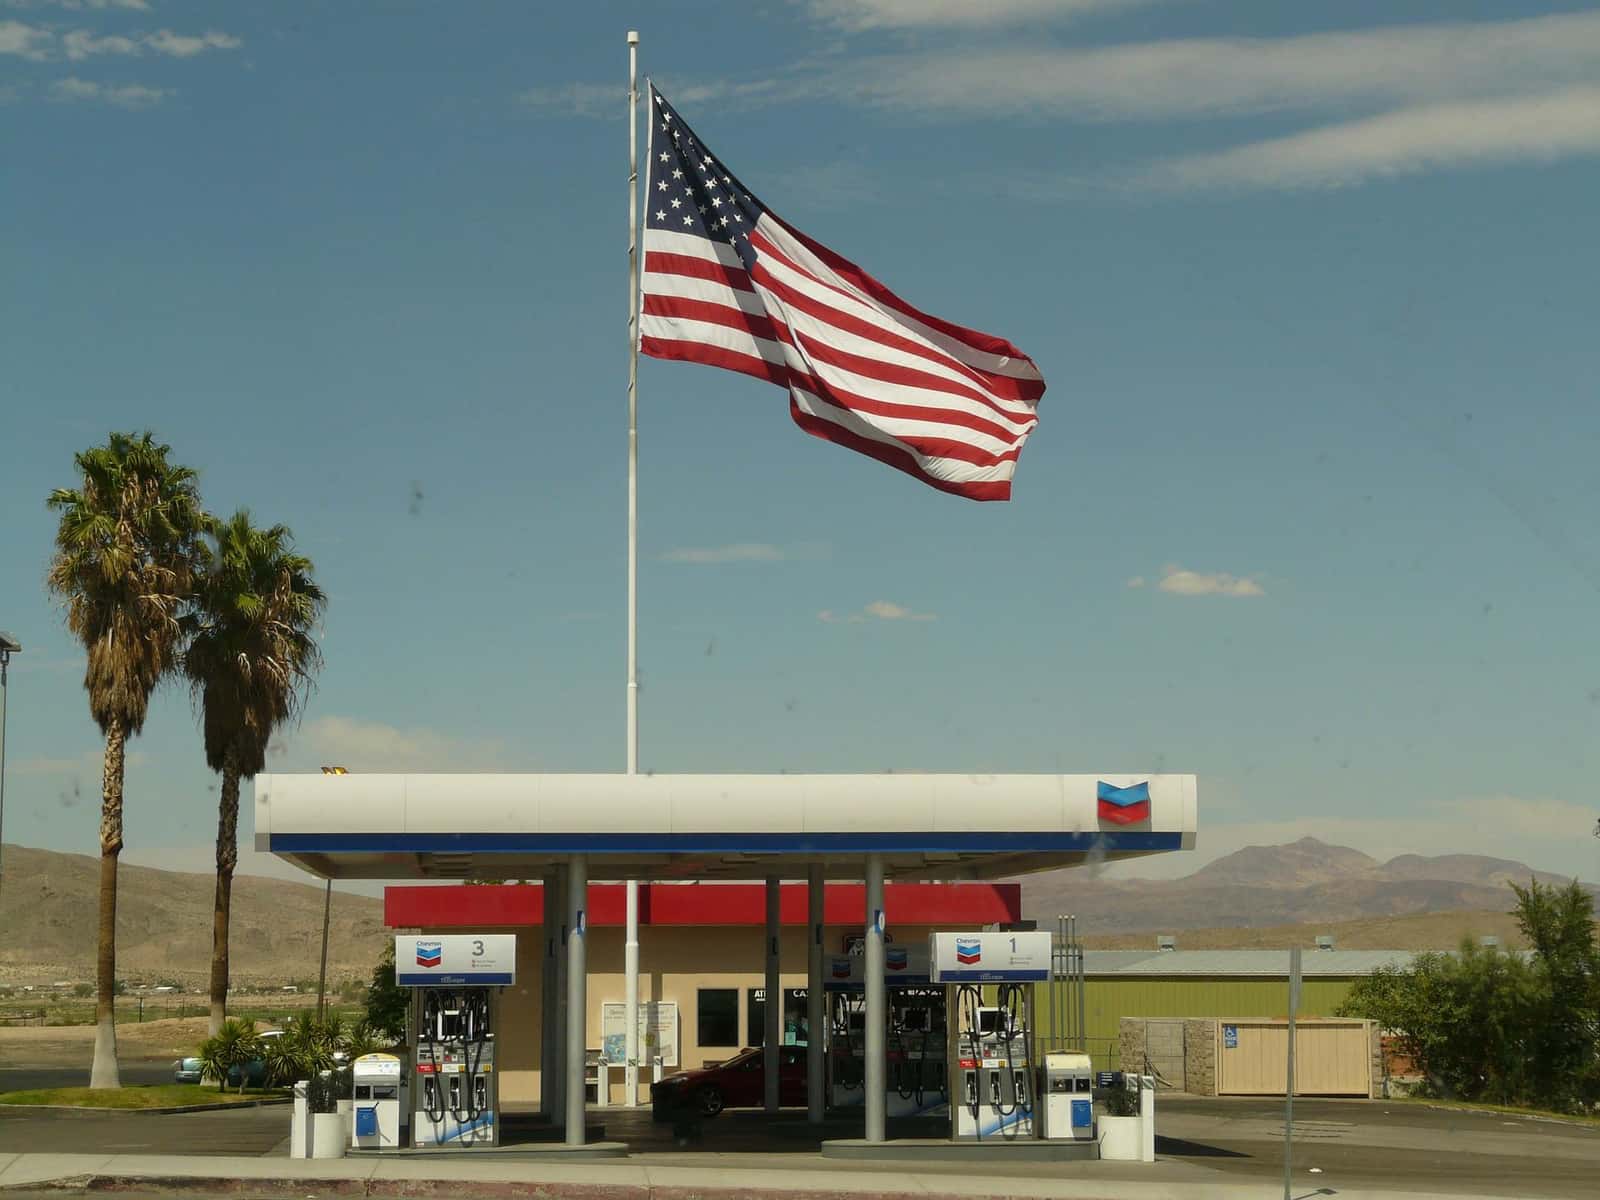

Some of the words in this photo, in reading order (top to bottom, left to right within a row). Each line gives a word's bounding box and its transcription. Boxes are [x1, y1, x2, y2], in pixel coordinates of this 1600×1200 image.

[472, 940, 484, 956] 3
[1009, 937, 1016, 953] 1
[754, 990, 766, 998] AT
